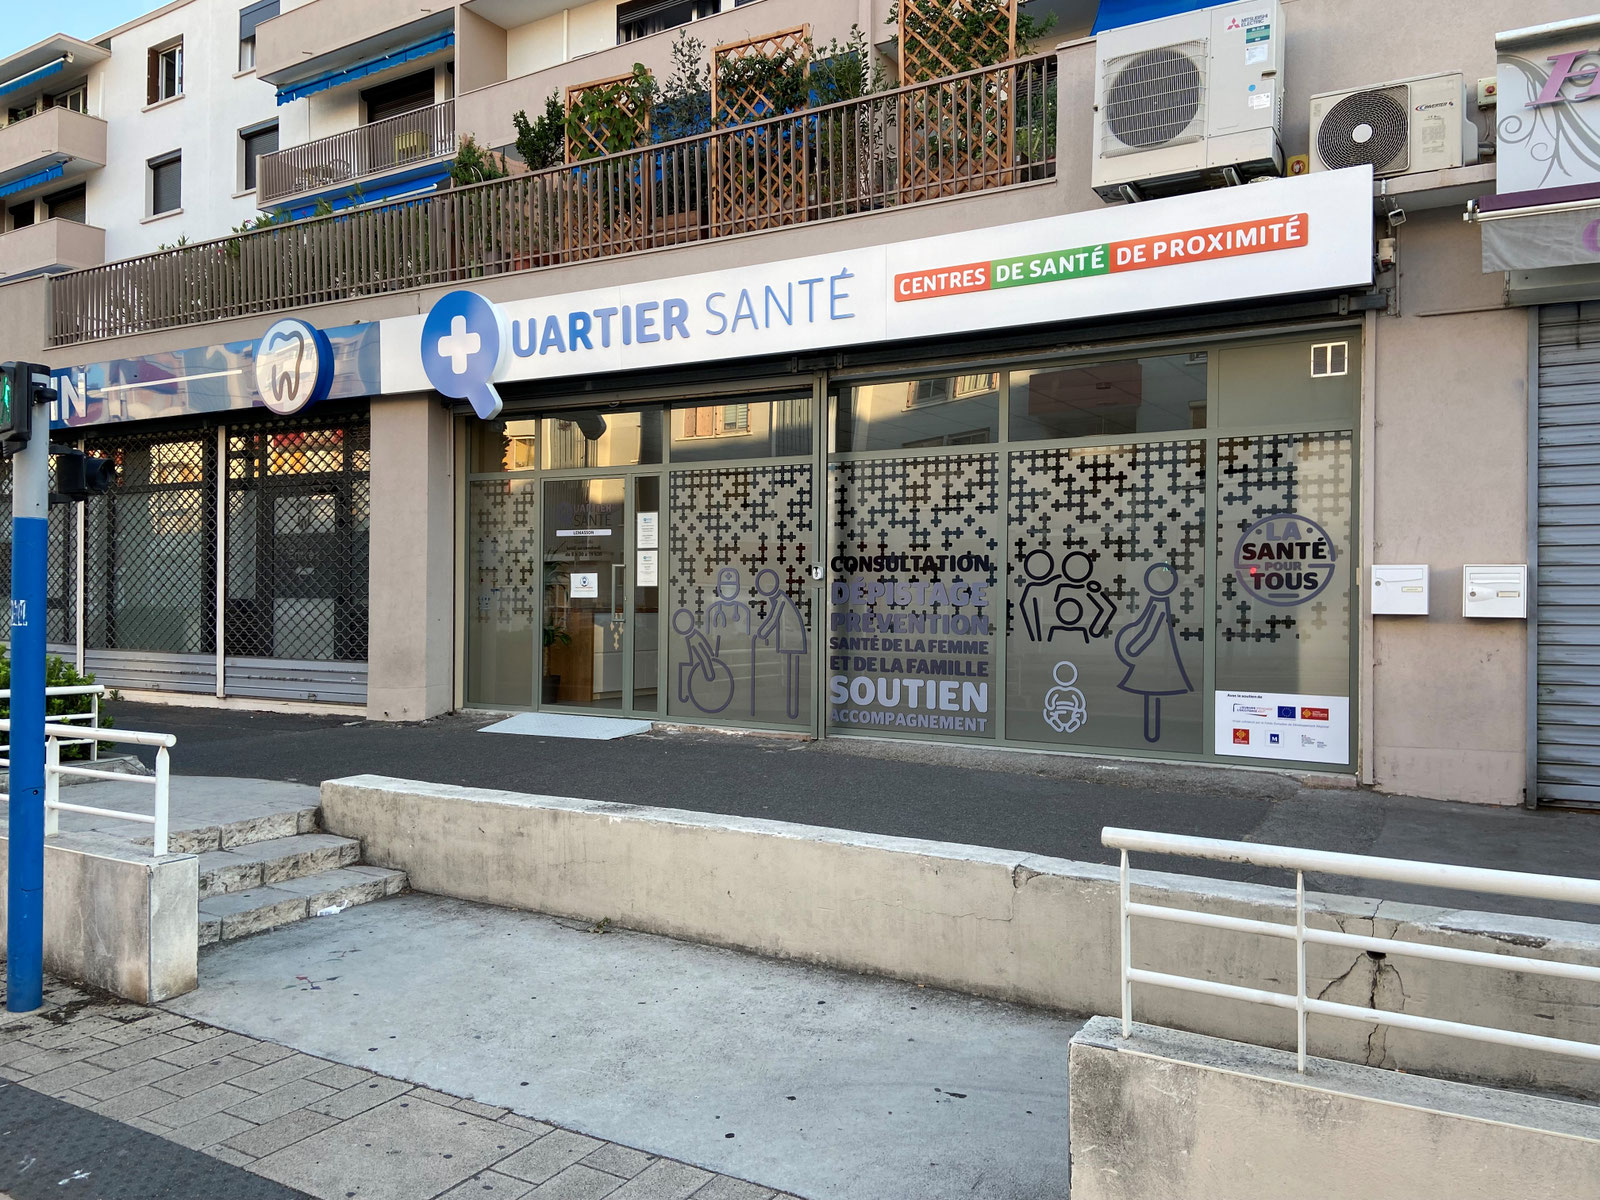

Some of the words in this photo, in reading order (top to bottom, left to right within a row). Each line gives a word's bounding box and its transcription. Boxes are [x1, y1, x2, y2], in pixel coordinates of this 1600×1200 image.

[1241, 19, 1264, 27] ELECTRIC
[899, 267, 986, 296] CENTRES
[995, 261, 1024, 283] DE
[1029, 245, 1105, 278] SANTÉ
[1116, 244, 1147, 267] DE
[1153, 214, 1301, 260] PROXIMITÉ
[705, 266, 856, 336] SANTÉ
[1266, 521, 1302, 541] LA
[1242, 537, 1327, 560] SANTÉ
[831, 554, 989, 573] CONSULTATION
[1264, 561, 1302, 571] POUR
[831, 577, 989, 606] DÉPISTAGE
[1250, 572, 1318, 590] TOUS
[831, 608, 989, 635] PRÉVENTION
[829, 635, 879, 651] SANTÉ
[881, 638, 903, 652] DE
[904, 639, 926, 653] LA
[928, 640, 989, 655] FEMME
[830, 656, 851, 671] ET
[853, 656, 877, 672] DE
[880, 658, 903, 674] LA
[907, 658, 989, 677] FAMILLE
[829, 675, 988, 713] SOUTIEN
[830, 709, 988, 731] ACCOMPAGNEMENT
